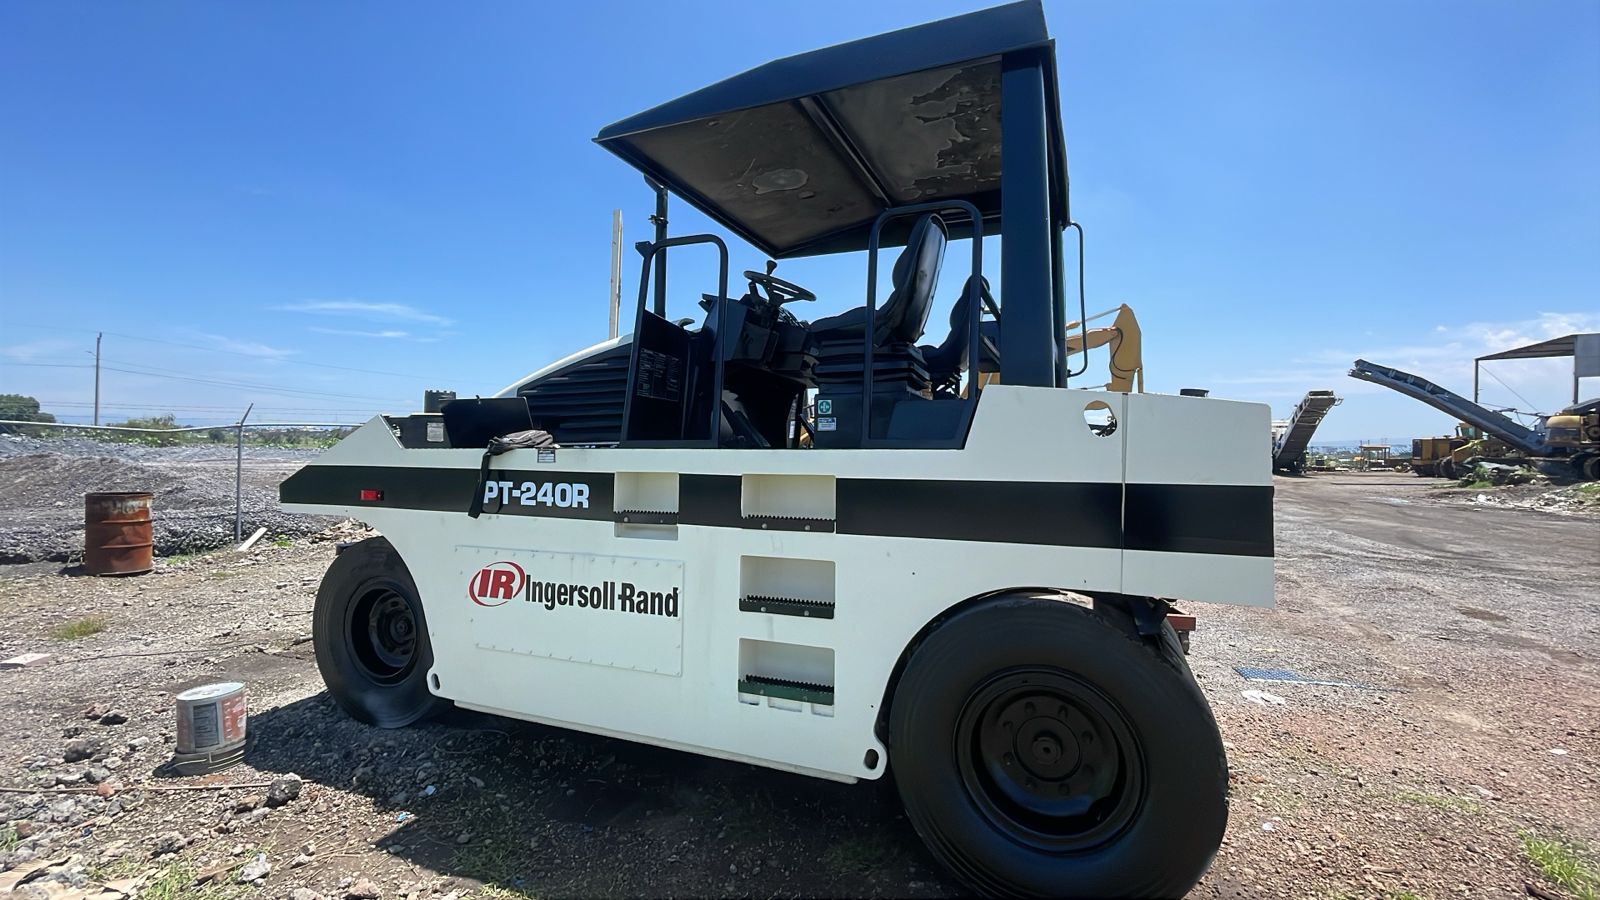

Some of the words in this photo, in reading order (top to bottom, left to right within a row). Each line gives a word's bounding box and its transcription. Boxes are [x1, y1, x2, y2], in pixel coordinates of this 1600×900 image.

[483, 480, 590, 509] PT-240R
[477, 568, 516, 600] IR
[525, 574, 679, 618] Ingersoll-Rand
